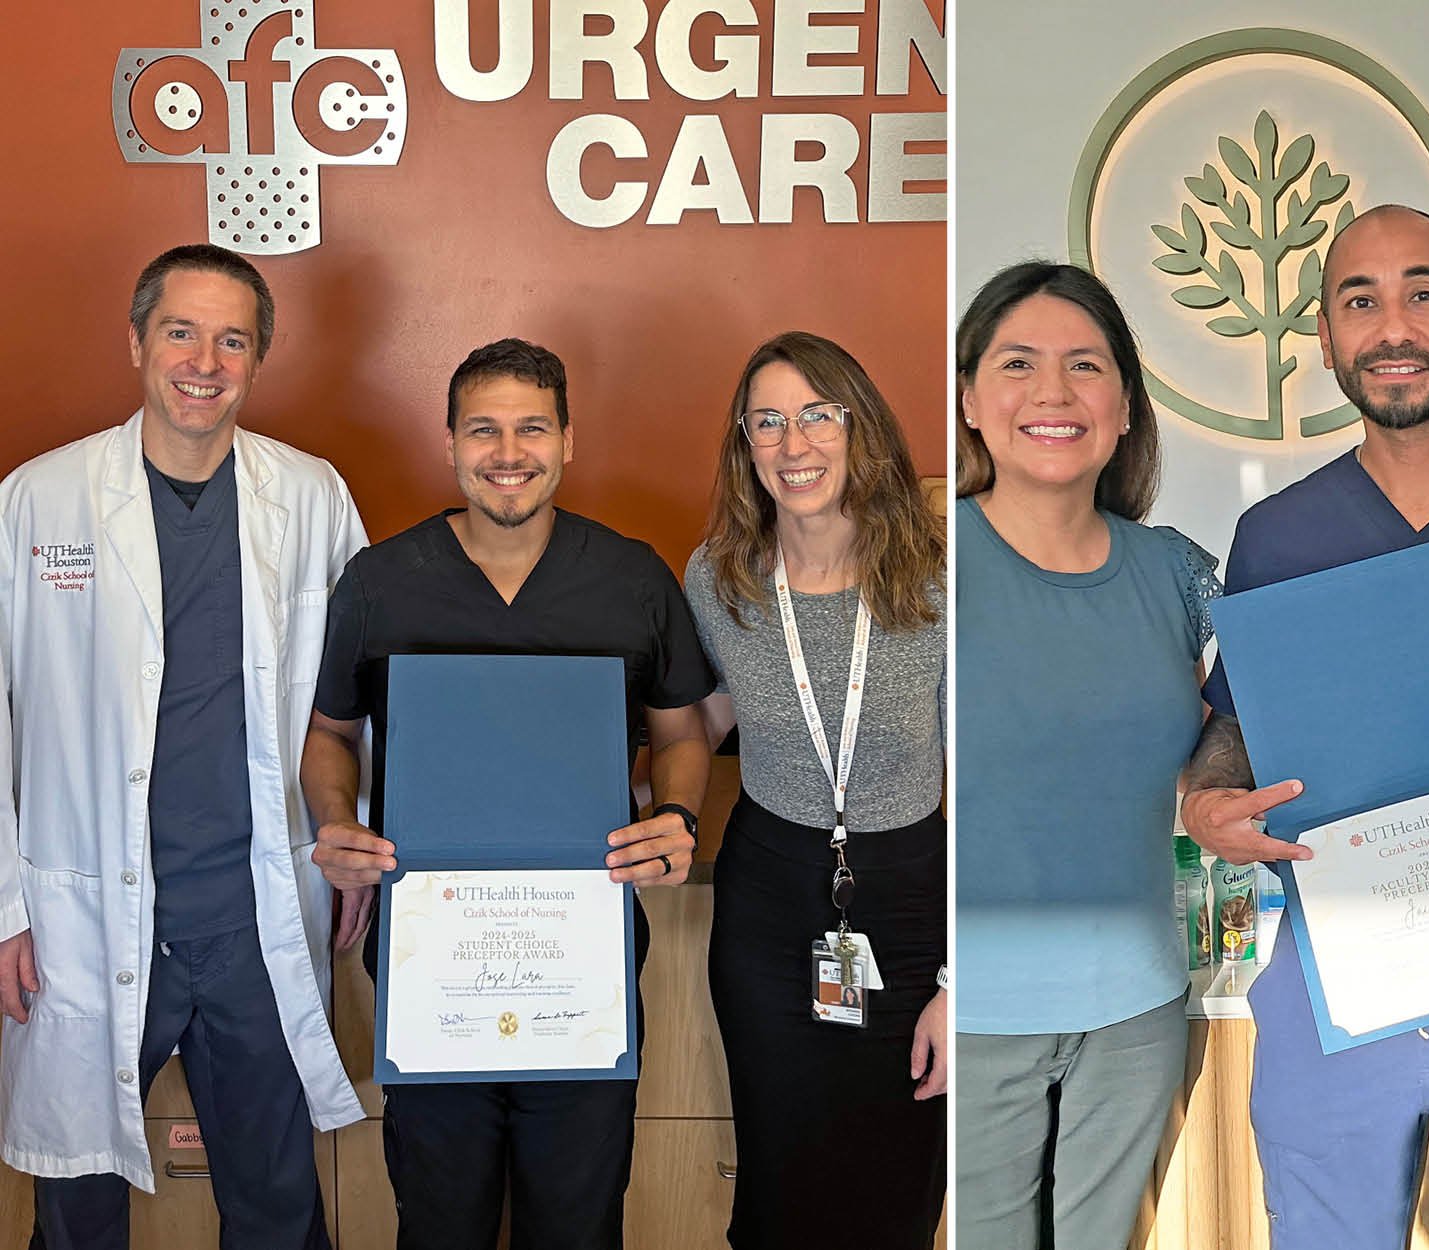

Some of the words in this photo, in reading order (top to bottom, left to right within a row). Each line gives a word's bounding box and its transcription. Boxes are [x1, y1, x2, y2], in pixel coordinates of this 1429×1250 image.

[131, 9, 390, 155] afc
[546, 113, 947, 228] CARE
[40, 544, 93, 556] UTHealth
[47, 557, 91, 567] Houston
[63, 571, 88, 580] School
[55, 582, 85, 591] Nursing
[1371, 871, 1429, 895] FACULTY
[456, 886, 520, 901] UTHealth
[523, 887, 575, 901] Houston
[490, 907, 519, 918] School
[520, 907, 530, 918] of
[532, 908, 567, 920] Nursing
[481, 931, 536, 940] 2024-2025
[457, 941, 511, 950] STUDENT
[515, 940, 559, 949] CHOICE
[453, 950, 520, 961] PRECEPTOR
[523, 950, 564, 960] AWARD
[511, 961, 544, 989] Lara
[175, 1131, 202, 1143] Gabb
